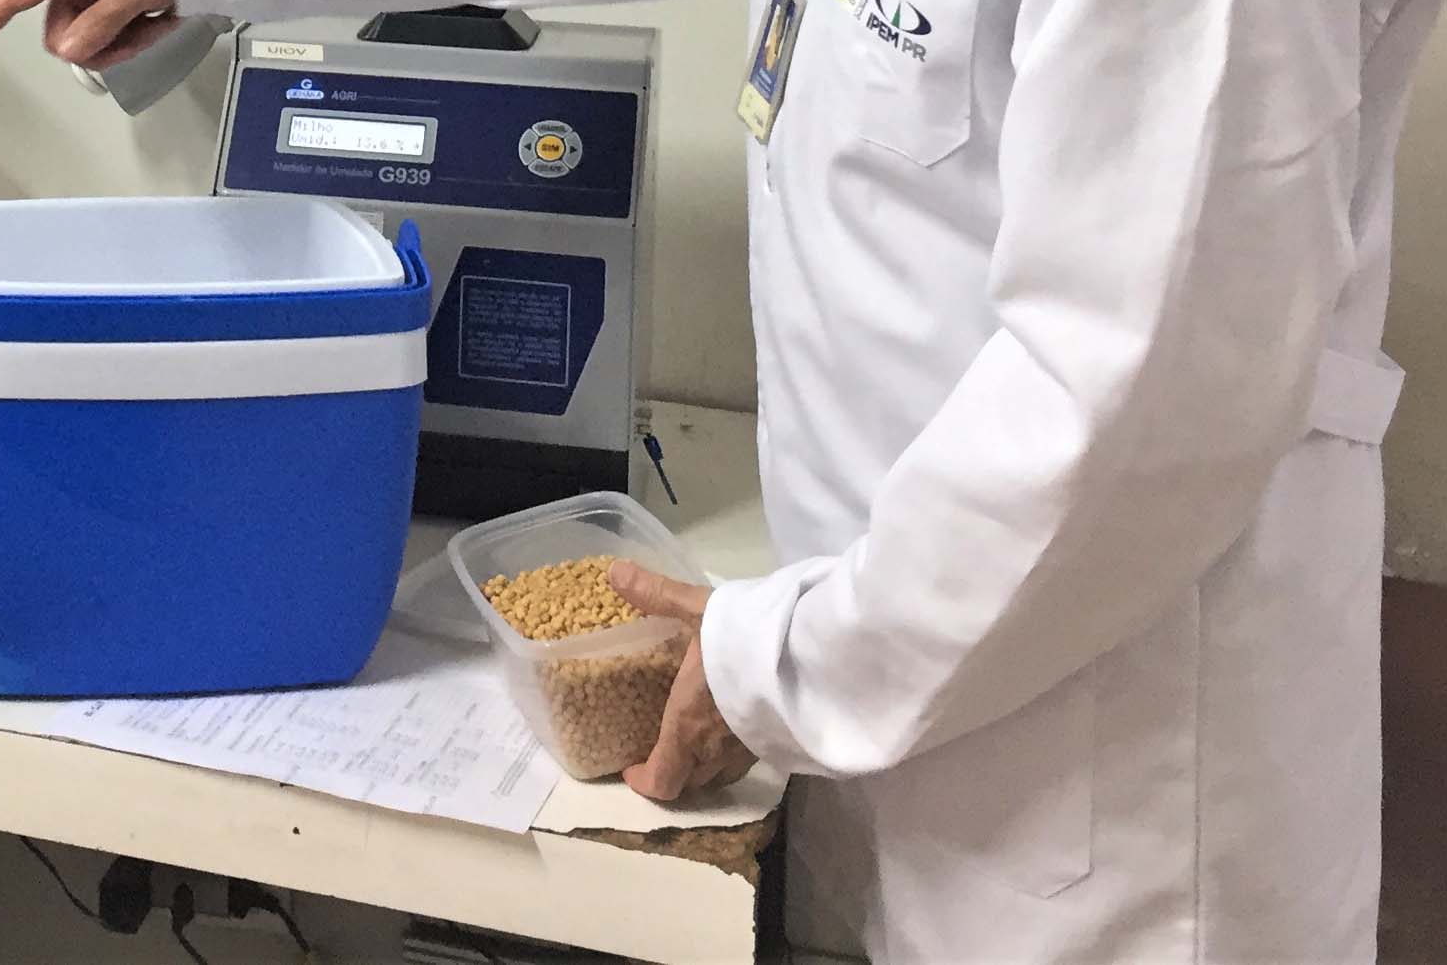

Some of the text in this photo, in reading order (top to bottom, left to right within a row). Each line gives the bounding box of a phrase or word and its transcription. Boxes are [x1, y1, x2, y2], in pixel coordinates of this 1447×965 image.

[866, 12, 927, 63] IPEM PR
[301, 78, 312, 89] G
[293, 120, 334, 133] Milho
[378, 166, 431, 186] G939
